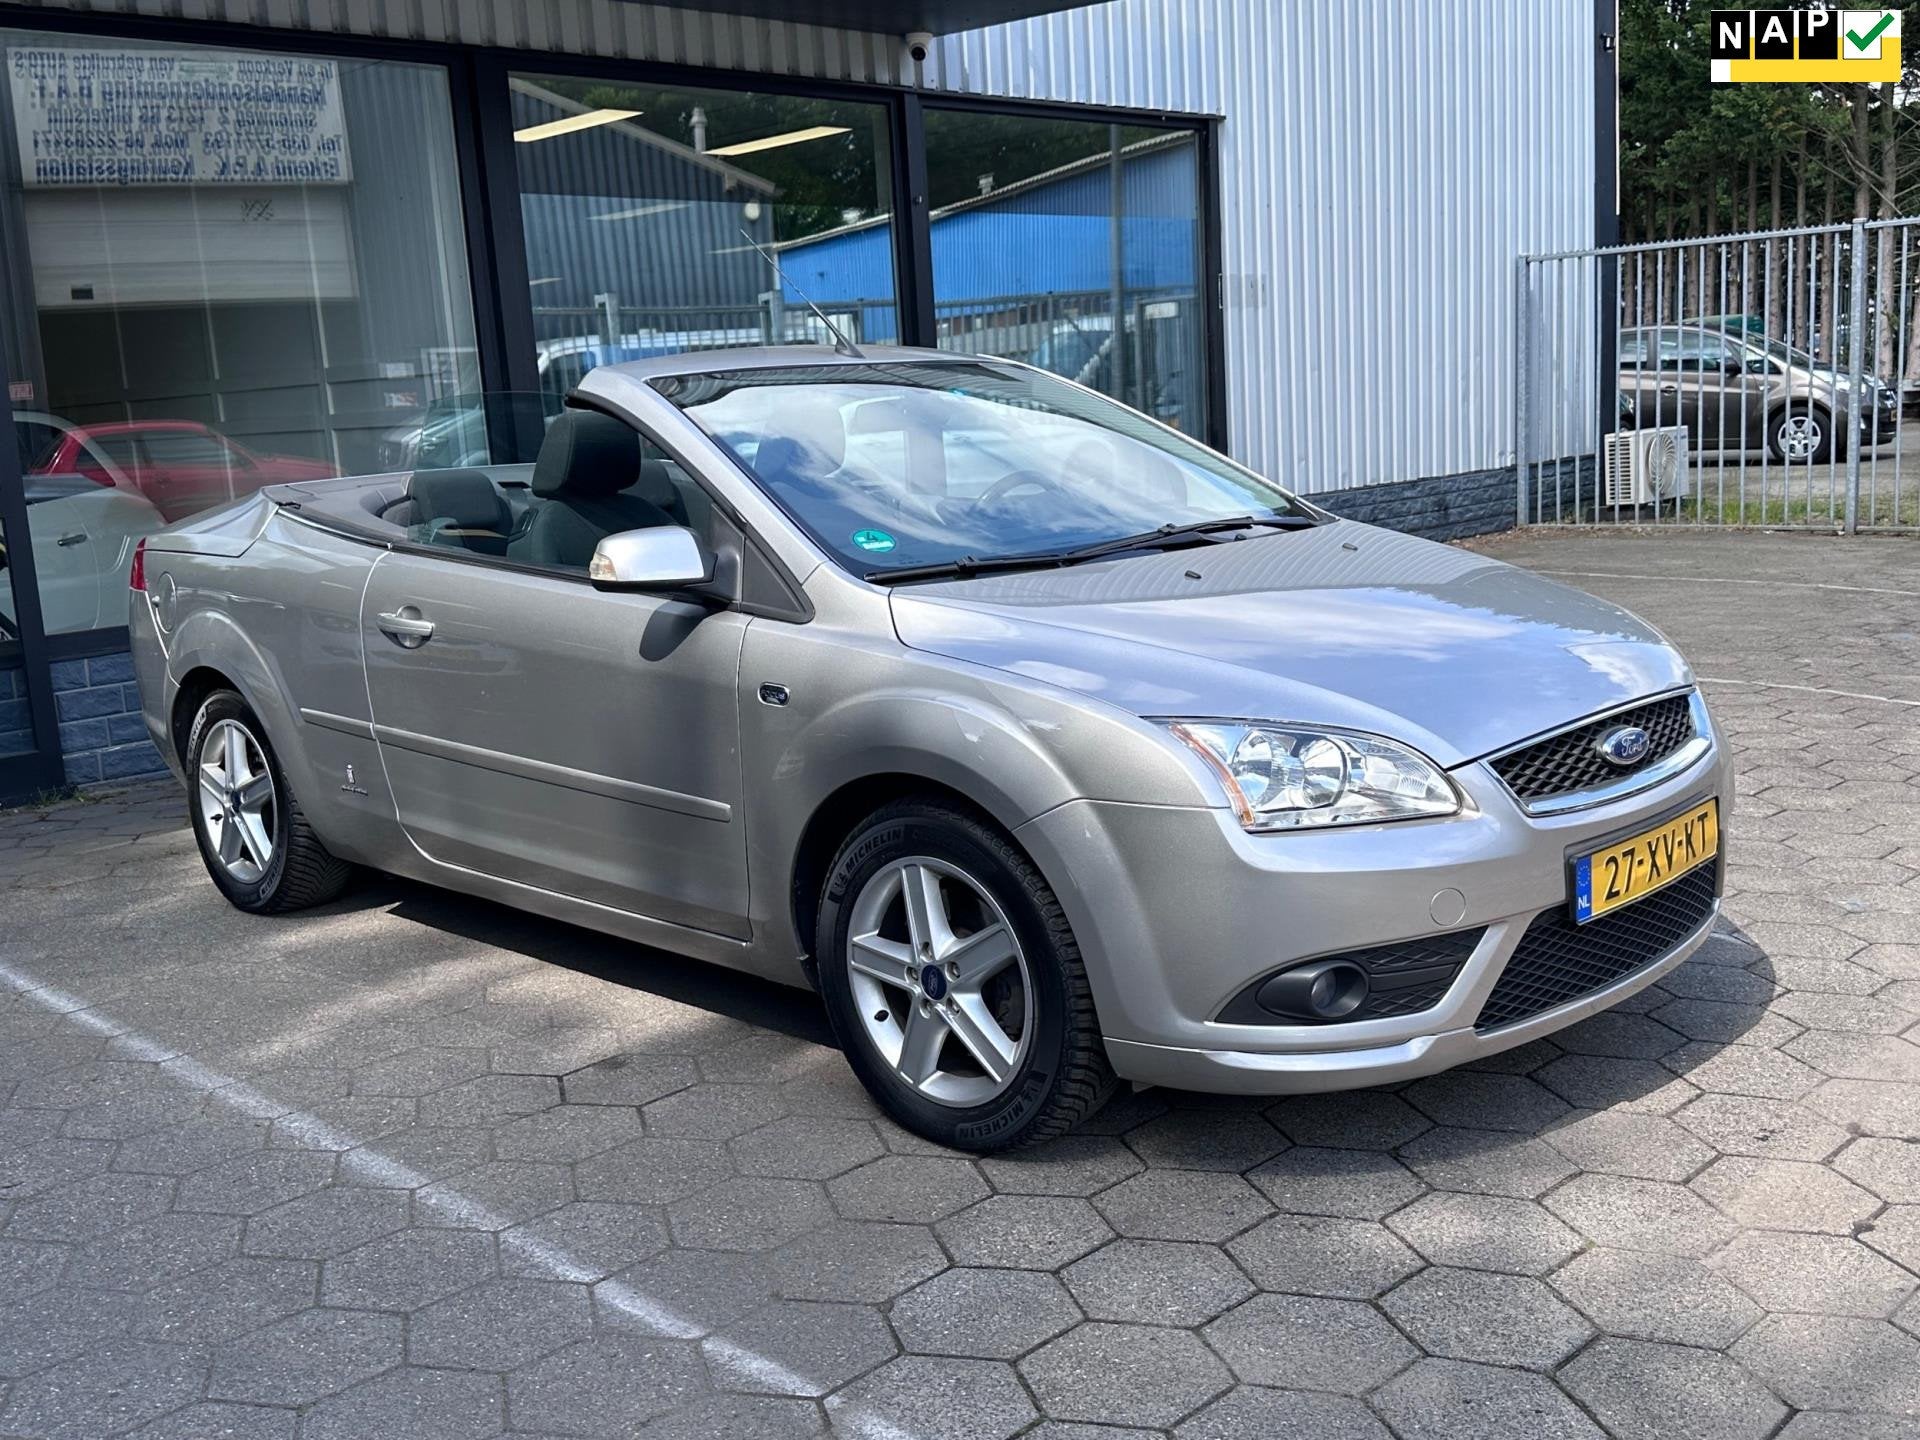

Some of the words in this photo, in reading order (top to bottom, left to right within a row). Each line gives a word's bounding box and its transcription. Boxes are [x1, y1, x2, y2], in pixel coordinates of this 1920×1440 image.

[1621, 735, 1643, 757] Ford
[844, 827, 903, 875] MICHELIN
[1603, 811, 1709, 903] 27-XV-KT
[1577, 894, 1591, 911] NL
